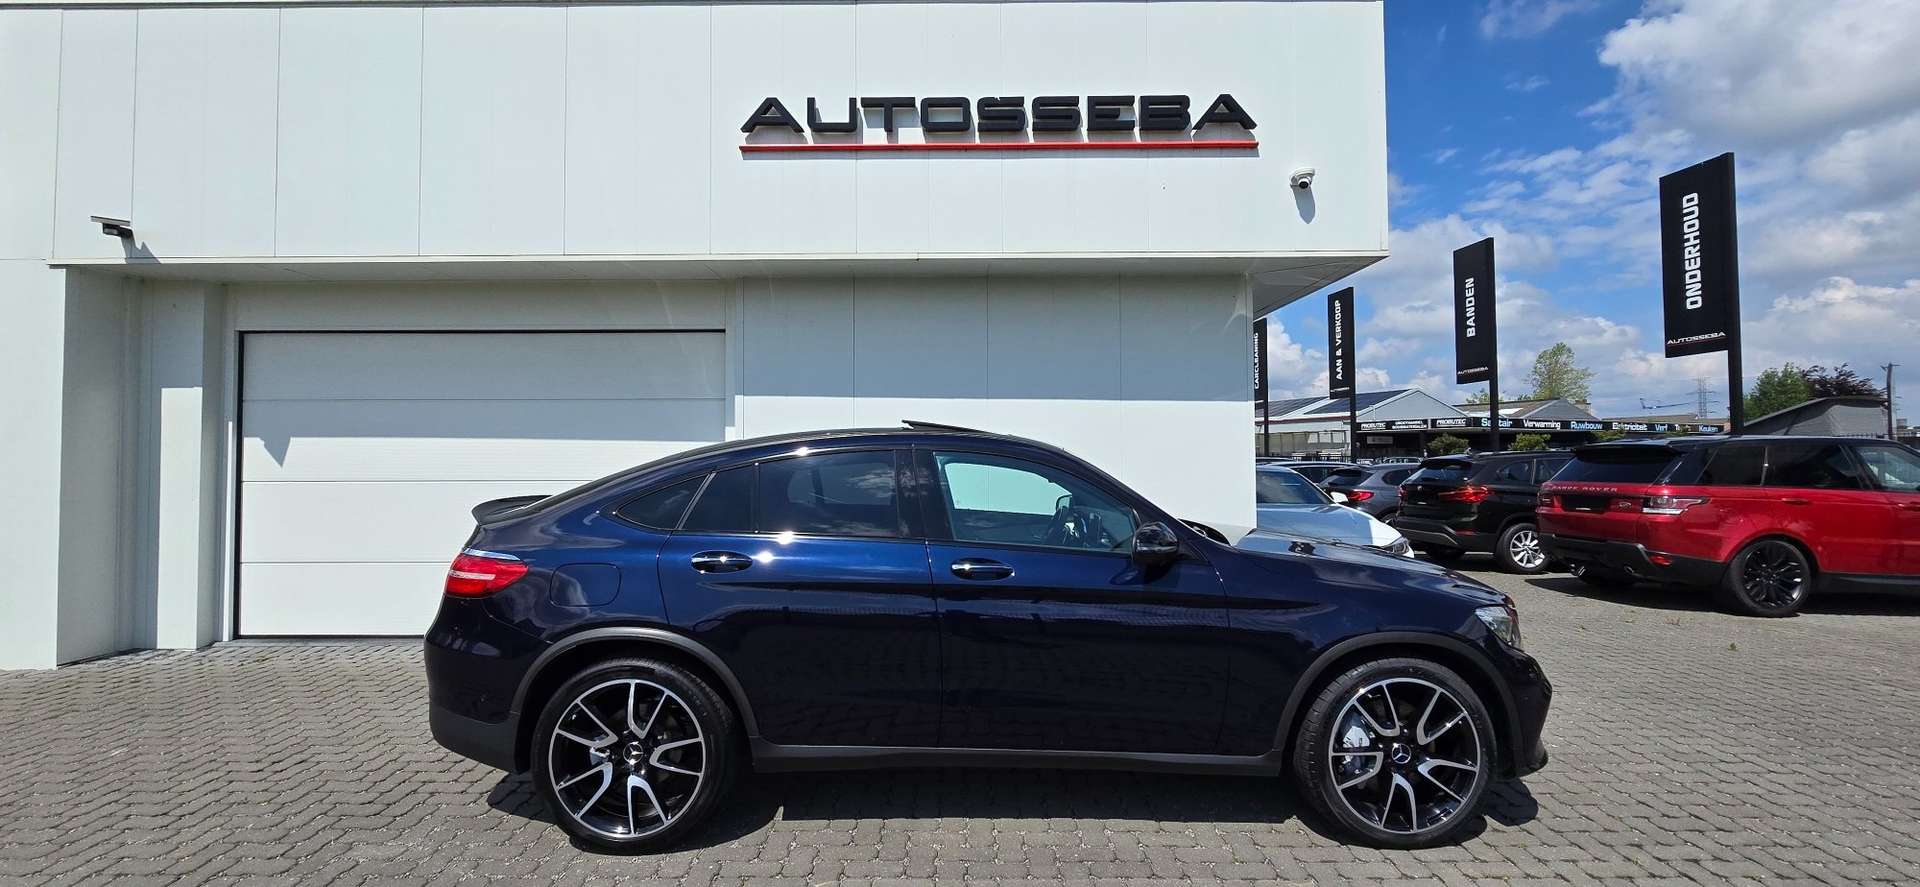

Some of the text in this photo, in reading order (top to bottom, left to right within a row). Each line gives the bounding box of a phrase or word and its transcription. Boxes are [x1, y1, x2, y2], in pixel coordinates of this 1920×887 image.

[741, 94, 1257, 133] AUTOSSEBA
[1683, 192, 1703, 310] ONDERHOUD
[1465, 278, 1476, 337] BANDEN
[1334, 300, 1342, 346] VERKOOP
[1667, 331, 1726, 344] AUTOSSEBA
[1481, 418, 1512, 427] Satair
[1523, 419, 1561, 430] Verwarming
[1570, 421, 1603, 430] Ruwbouw
